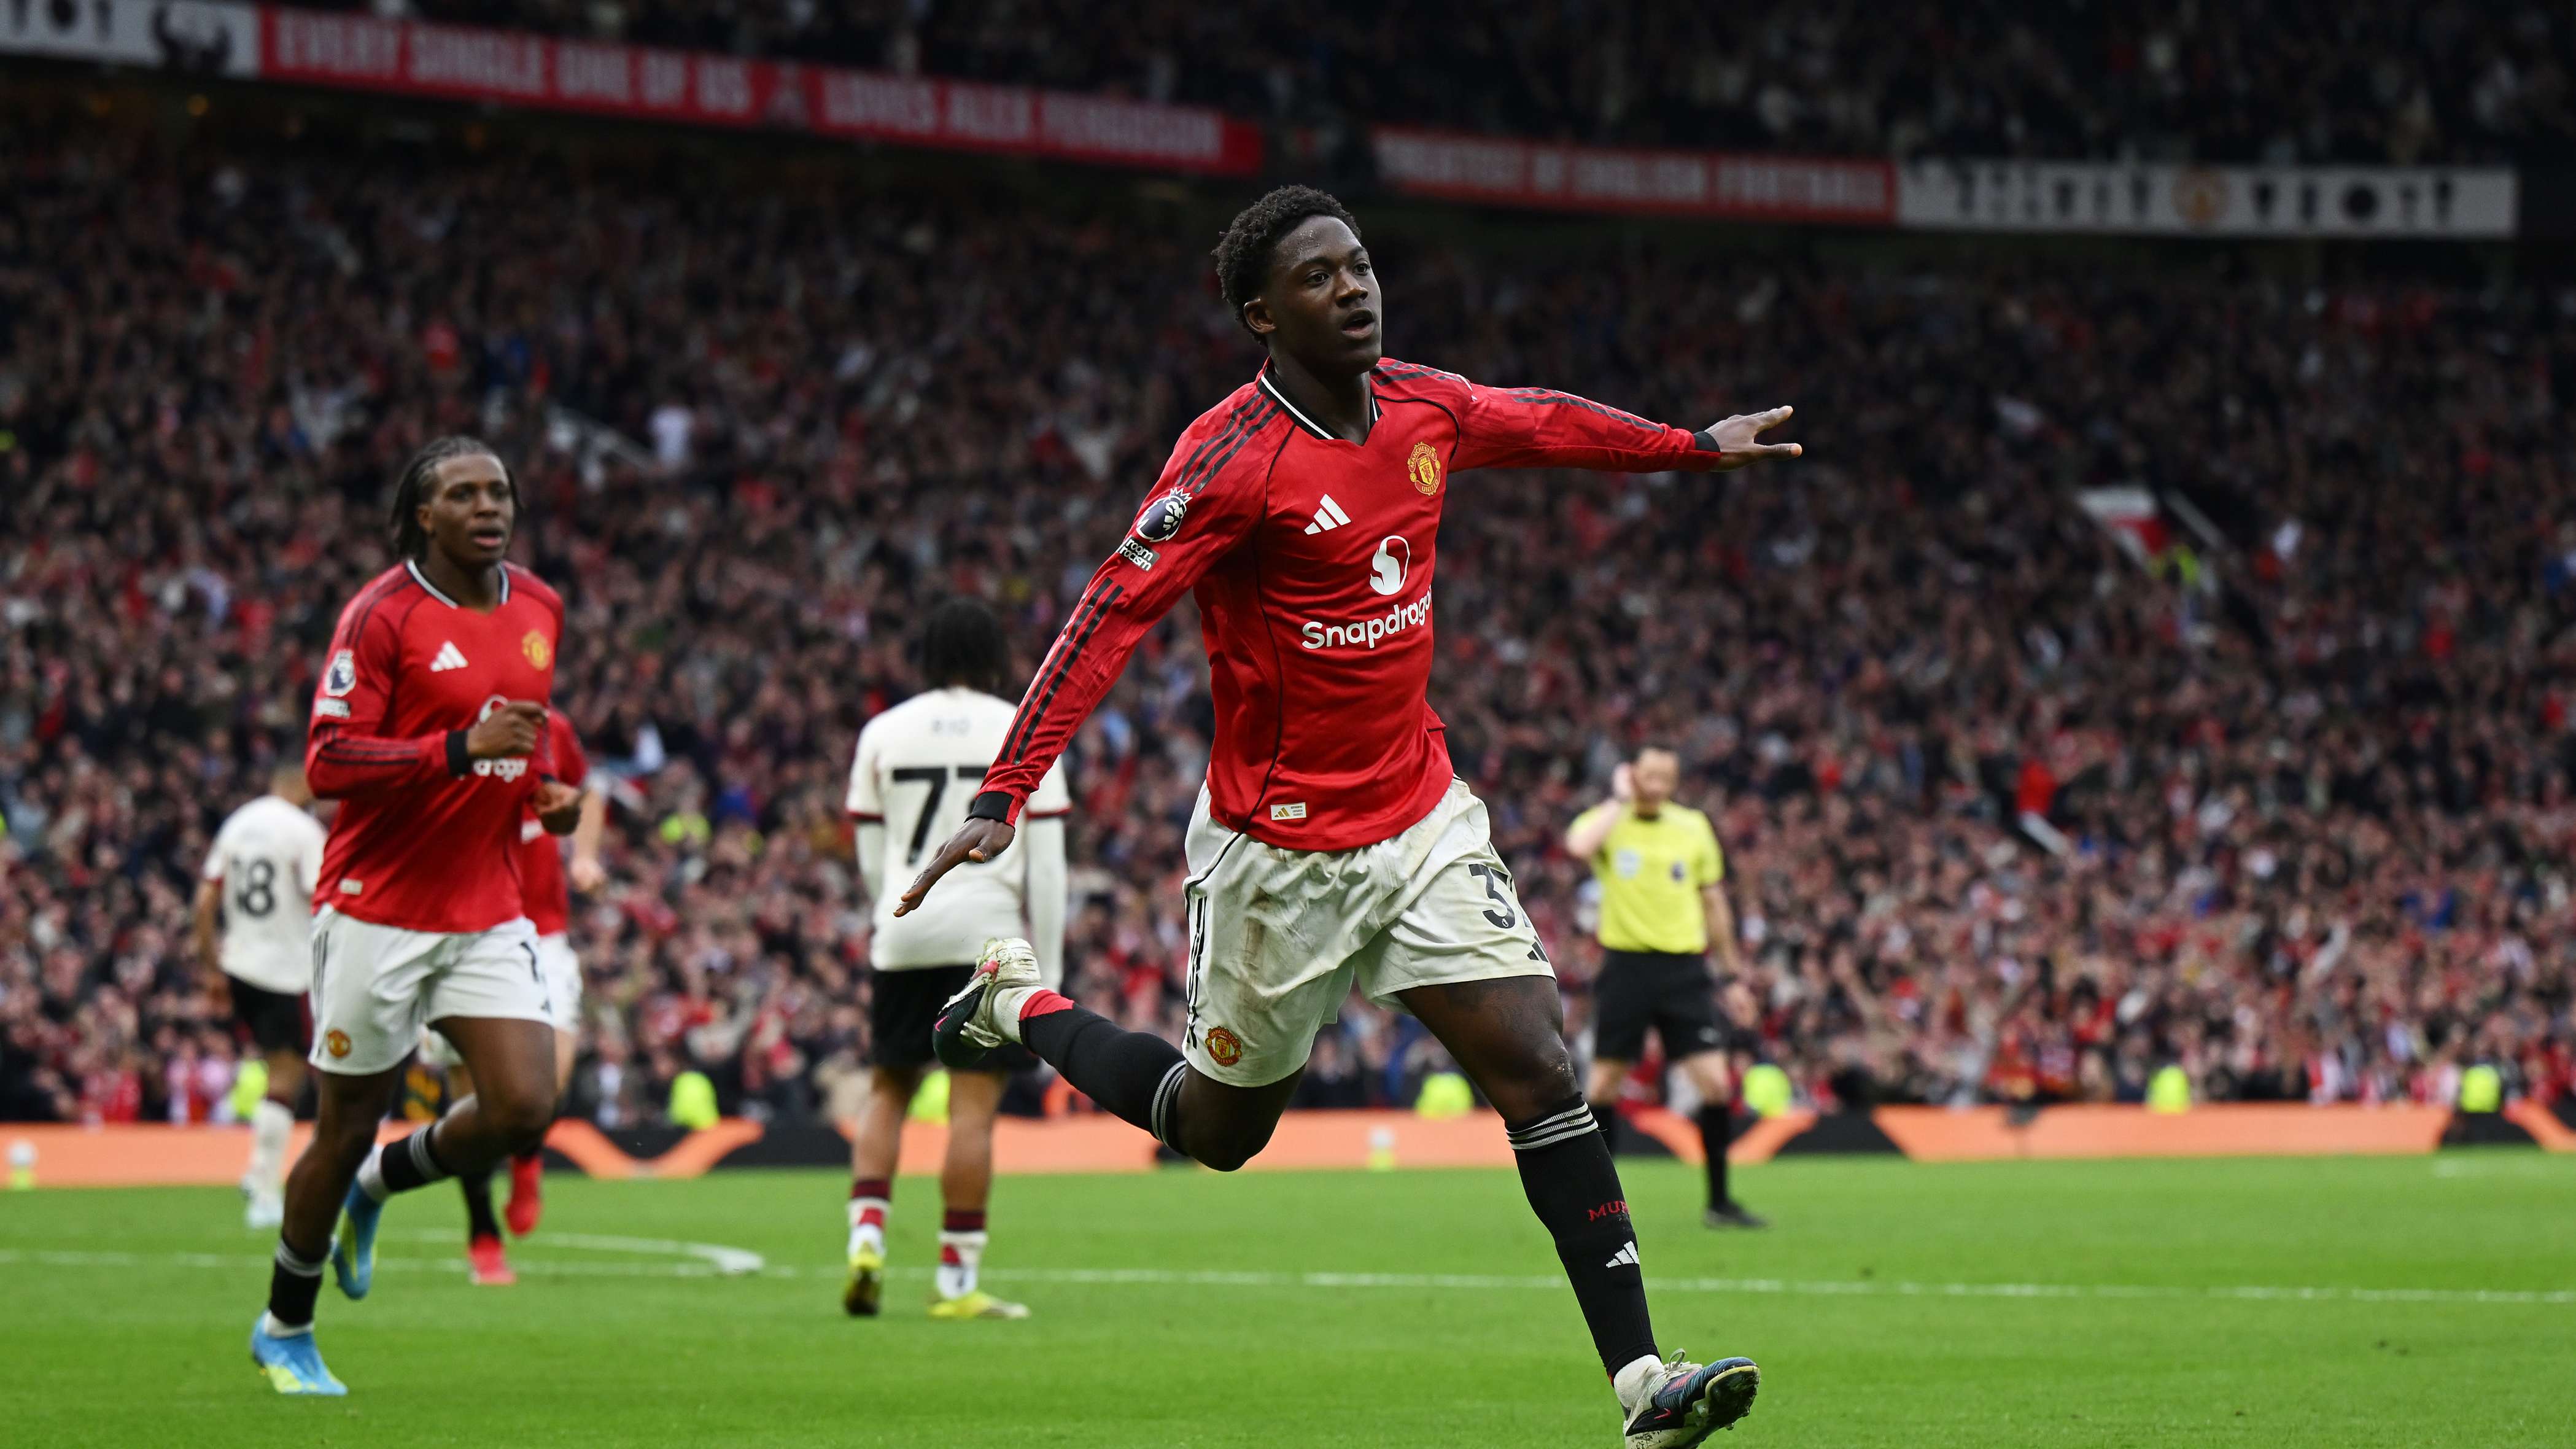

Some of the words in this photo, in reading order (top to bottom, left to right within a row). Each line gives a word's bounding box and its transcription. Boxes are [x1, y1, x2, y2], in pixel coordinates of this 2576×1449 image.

[1119, 546, 1152, 571] racism
[1126, 538, 1154, 561] room
[1302, 584, 1432, 649] Snapdrago
